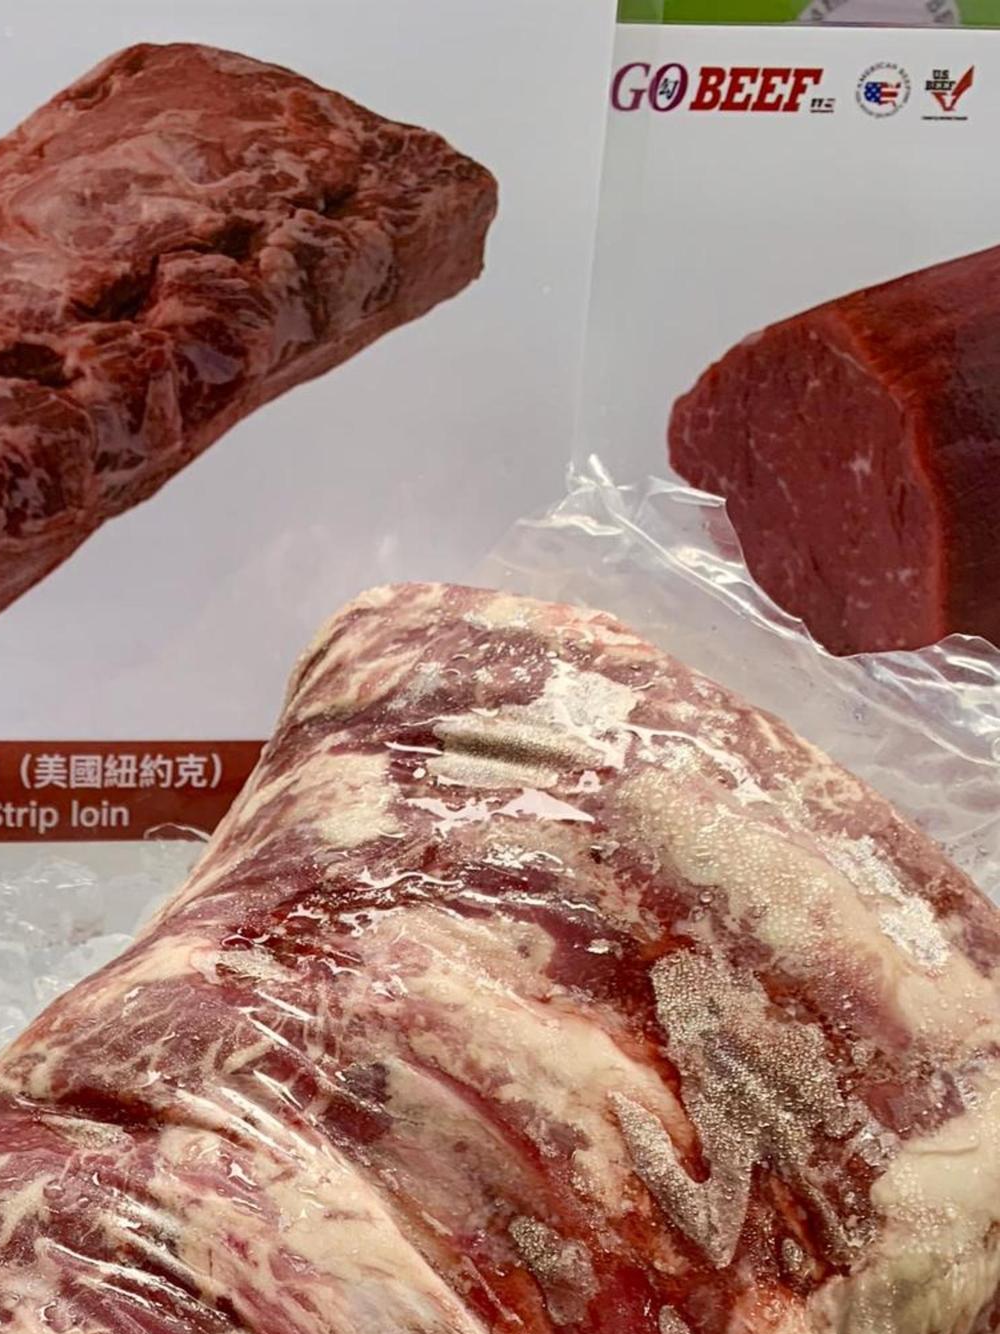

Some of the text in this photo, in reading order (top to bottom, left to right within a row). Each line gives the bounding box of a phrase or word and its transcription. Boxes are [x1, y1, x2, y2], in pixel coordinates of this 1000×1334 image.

[610, 61, 688, 112] GO
[689, 66, 824, 112] BEEF
[925, 81, 956, 91] BEEF
[71, 800, 130, 827] loin
